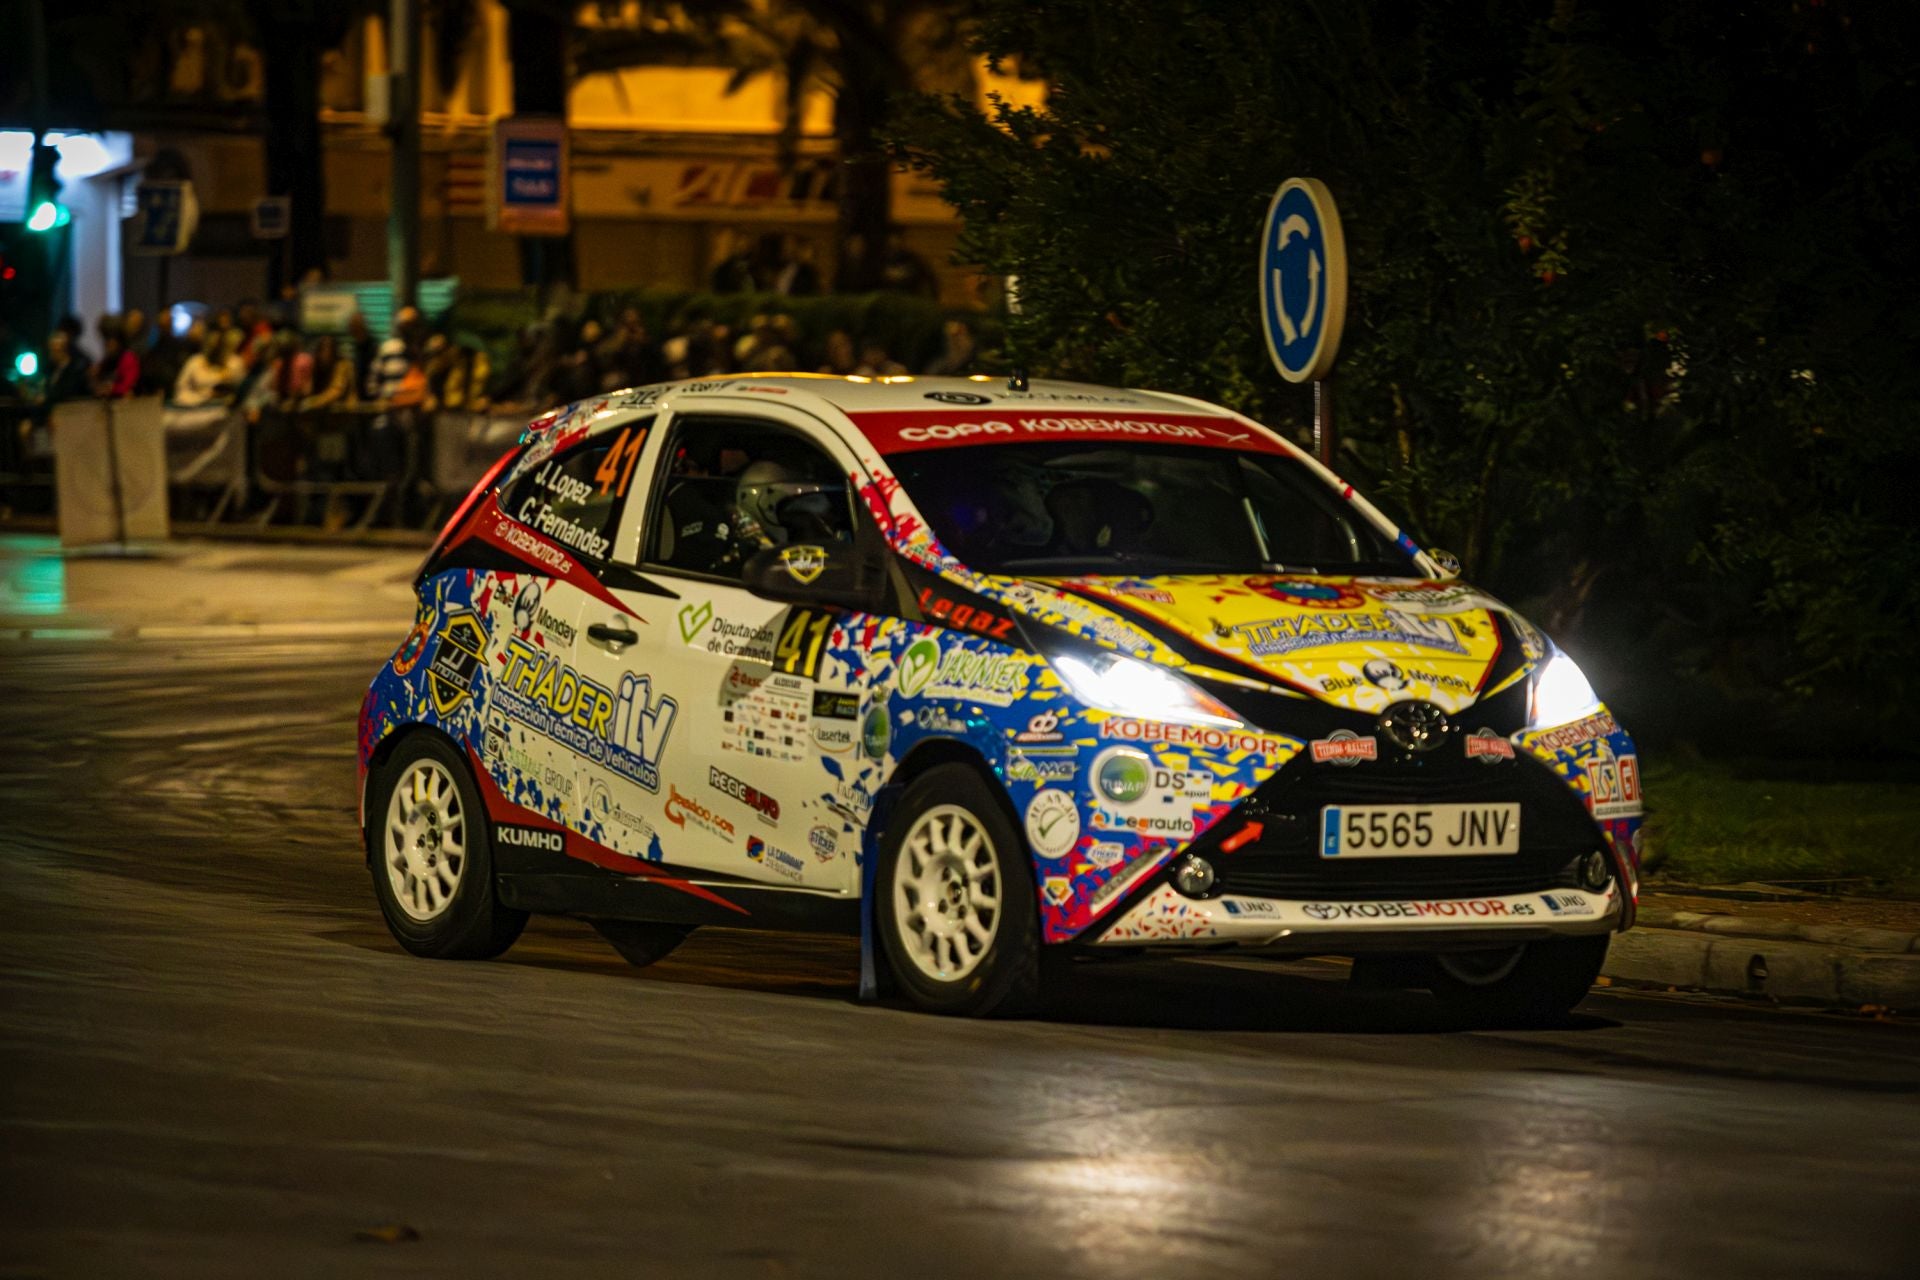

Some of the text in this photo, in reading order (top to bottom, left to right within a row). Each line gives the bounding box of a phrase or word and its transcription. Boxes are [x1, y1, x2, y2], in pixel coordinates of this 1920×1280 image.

[899, 417, 1206, 443] COPA KOBEMOTOR
[594, 427, 648, 498] 41
[534, 460, 593, 507] J. Lopez
[518, 497, 610, 560] C. Fernández
[537, 607, 578, 647] Monday
[712, 617, 774, 644] Diputación
[776, 609, 832, 677] 41
[1236, 614, 1394, 646] THADER
[707, 638, 721, 653] de
[501, 642, 614, 739] THADER
[1322, 669, 1472, 693] Blue Monday
[588, 736, 604, 759] de
[1102, 718, 1281, 755] KOBEMOTOR
[1155, 771, 1185, 790] DS
[498, 827, 563, 853] KUMHO
[1347, 808, 1510, 849] 5565 JNV
[1342, 900, 1536, 919] KOBEMOTOR.es
